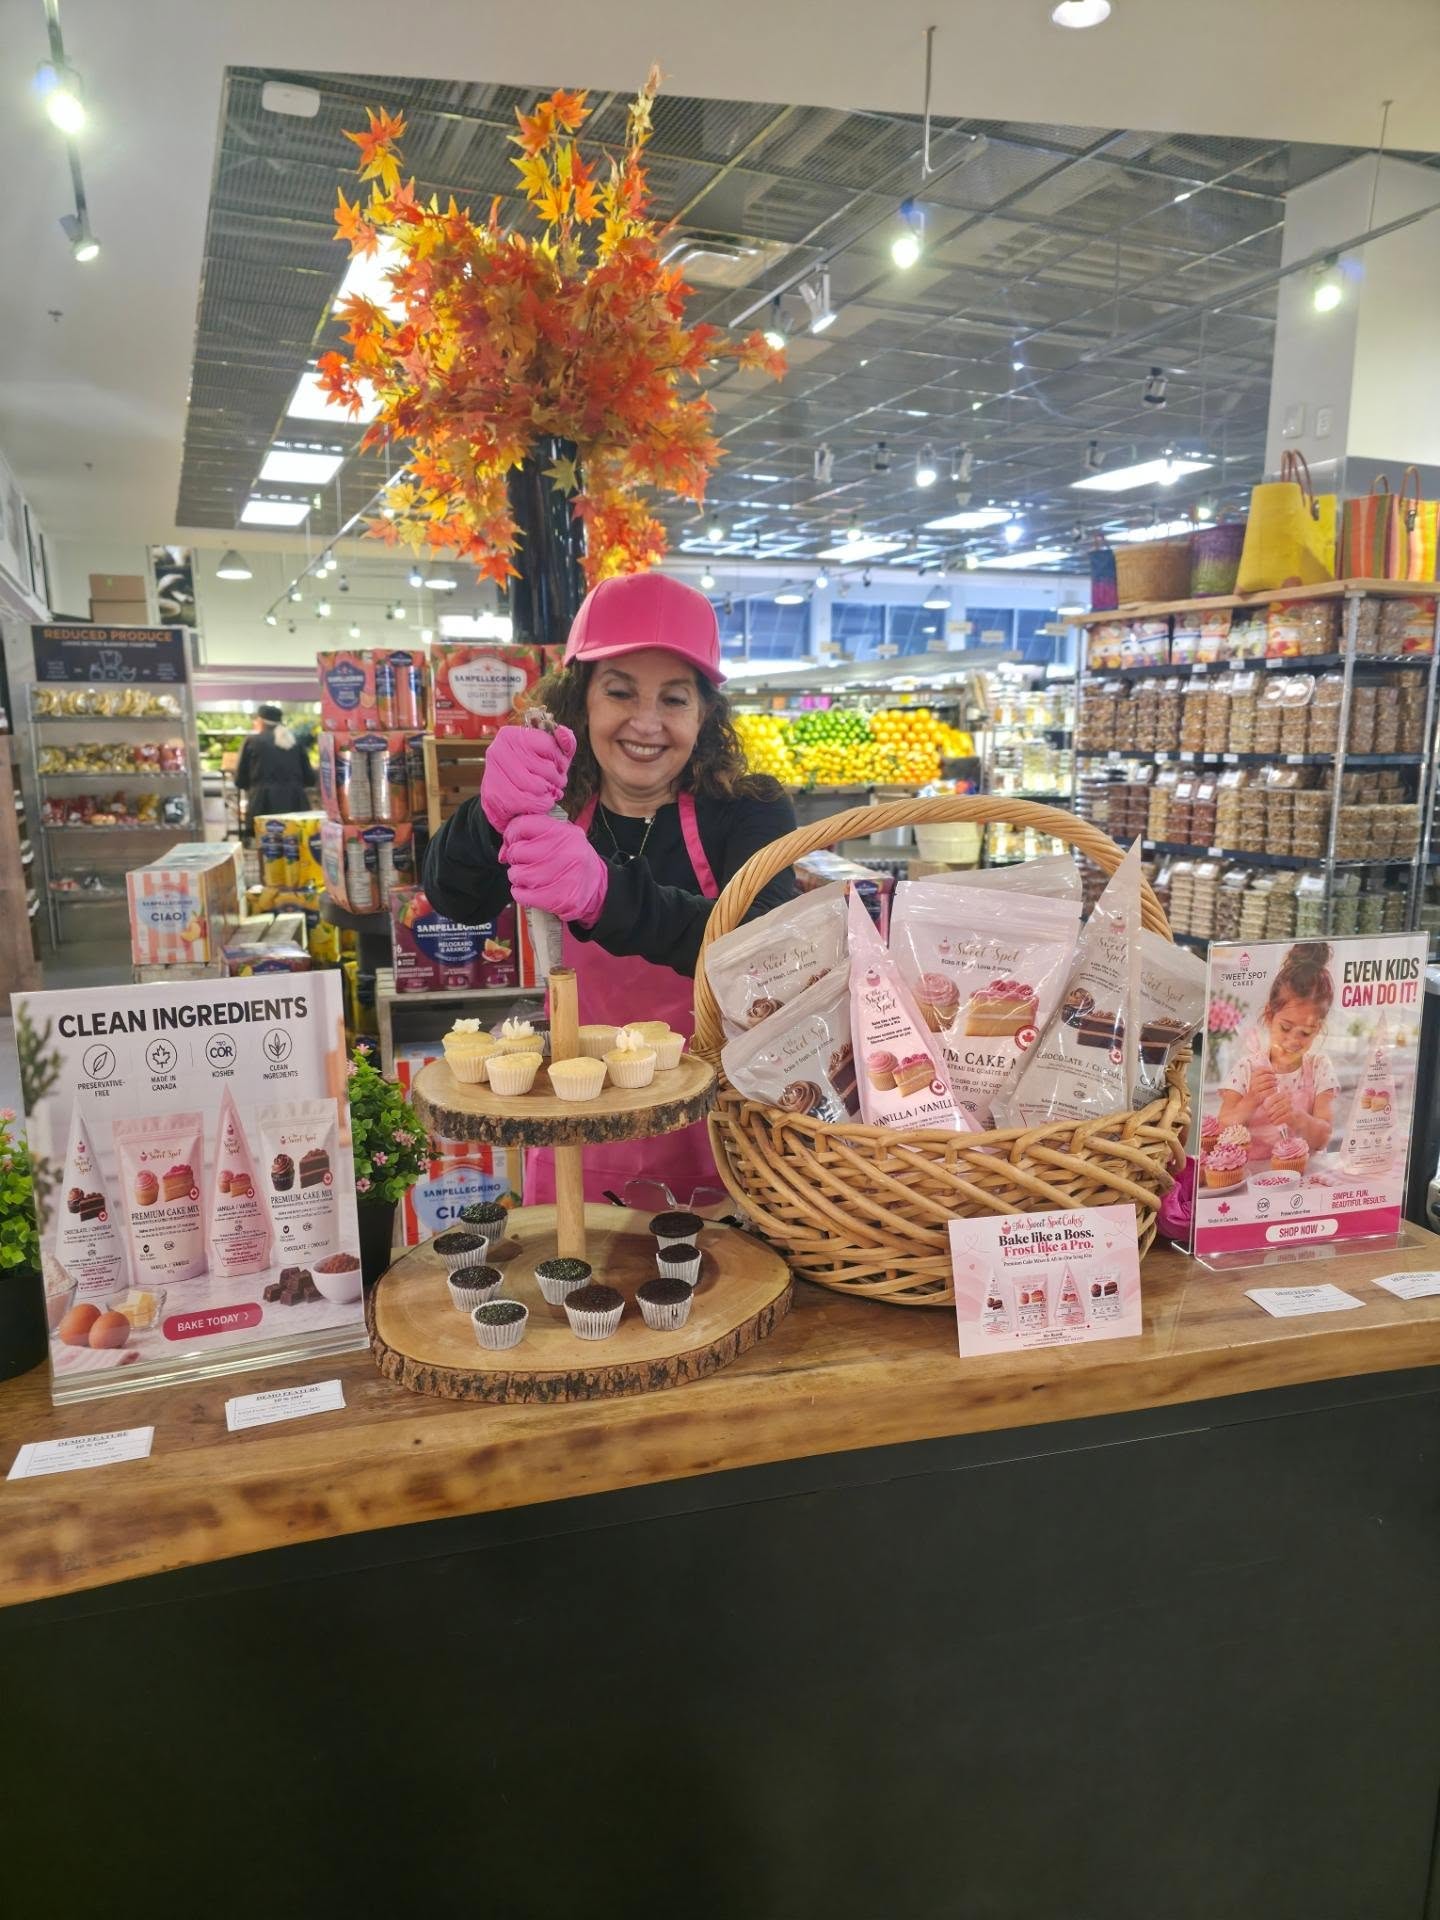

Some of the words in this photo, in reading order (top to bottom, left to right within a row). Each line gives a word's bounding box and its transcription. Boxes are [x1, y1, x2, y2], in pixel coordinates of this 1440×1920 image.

[43, 629, 106, 640] REDUCED
[110, 630, 173, 642] PRODUCE
[454, 674, 522, 684] SANPELLEGRINO
[151, 911, 187, 922] CIAO!
[1221, 972, 1246, 981] SWEET
[1248, 971, 1267, 980] SPOT
[1343, 960, 1383, 983] EVEN
[1385, 957, 1420, 981] KIDS
[1341, 984, 1372, 1007] CAN
[1376, 982, 1396, 1004] DO
[1399, 981, 1418, 1003] IT!
[58, 1010, 147, 1038] CLEAN
[153, 996, 308, 1031] INGREDIENTS
[210, 1046, 234, 1058] COR
[965, 1052, 1006, 1068] CAKE
[211, 1069, 235, 1078] KOSHER
[262, 1070, 299, 1080] INGREDIENTS
[269, 1064, 288, 1072] CLEAN
[151, 1075, 165, 1083] MADE
[168, 1074, 177, 1082] IN
[94, 1090, 110, 1098] FREE
[151, 1083, 177, 1092] CANADA
[873, 1110, 912, 1127] VANILLA
[271, 1194, 301, 1205] PREMIUM
[302, 1191, 320, 1200] CAKE
[321, 1189, 333, 1198] MIX
[424, 1183, 502, 1198] SANPELLEGRINO
[1331, 1198, 1362, 1209] BEAUTIFUL
[131, 1209, 165, 1220] PREMIUM
[166, 1206, 187, 1217] CAKE
[187, 1204, 200, 1213] MIX
[1025, 1217, 1045, 1230] Sweet
[1047, 1216, 1062, 1228] Spot
[1062, 1213, 1084, 1227] Cakes
[999, 1234, 1029, 1246] Bake
[1031, 1231, 1053, 1243] like
[1064, 1229, 1094, 1240] Boss.
[1279, 1227, 1299, 1238] SHOP
[1300, 1224, 1318, 1235] NOW
[1004, 1245, 1037, 1257] Frost
[1038, 1241, 1059, 1253] like
[1070, 1240, 1094, 1250] Pro.
[177, 1319, 204, 1332] BAKE
[206, 1312, 240, 1327] TODAY
